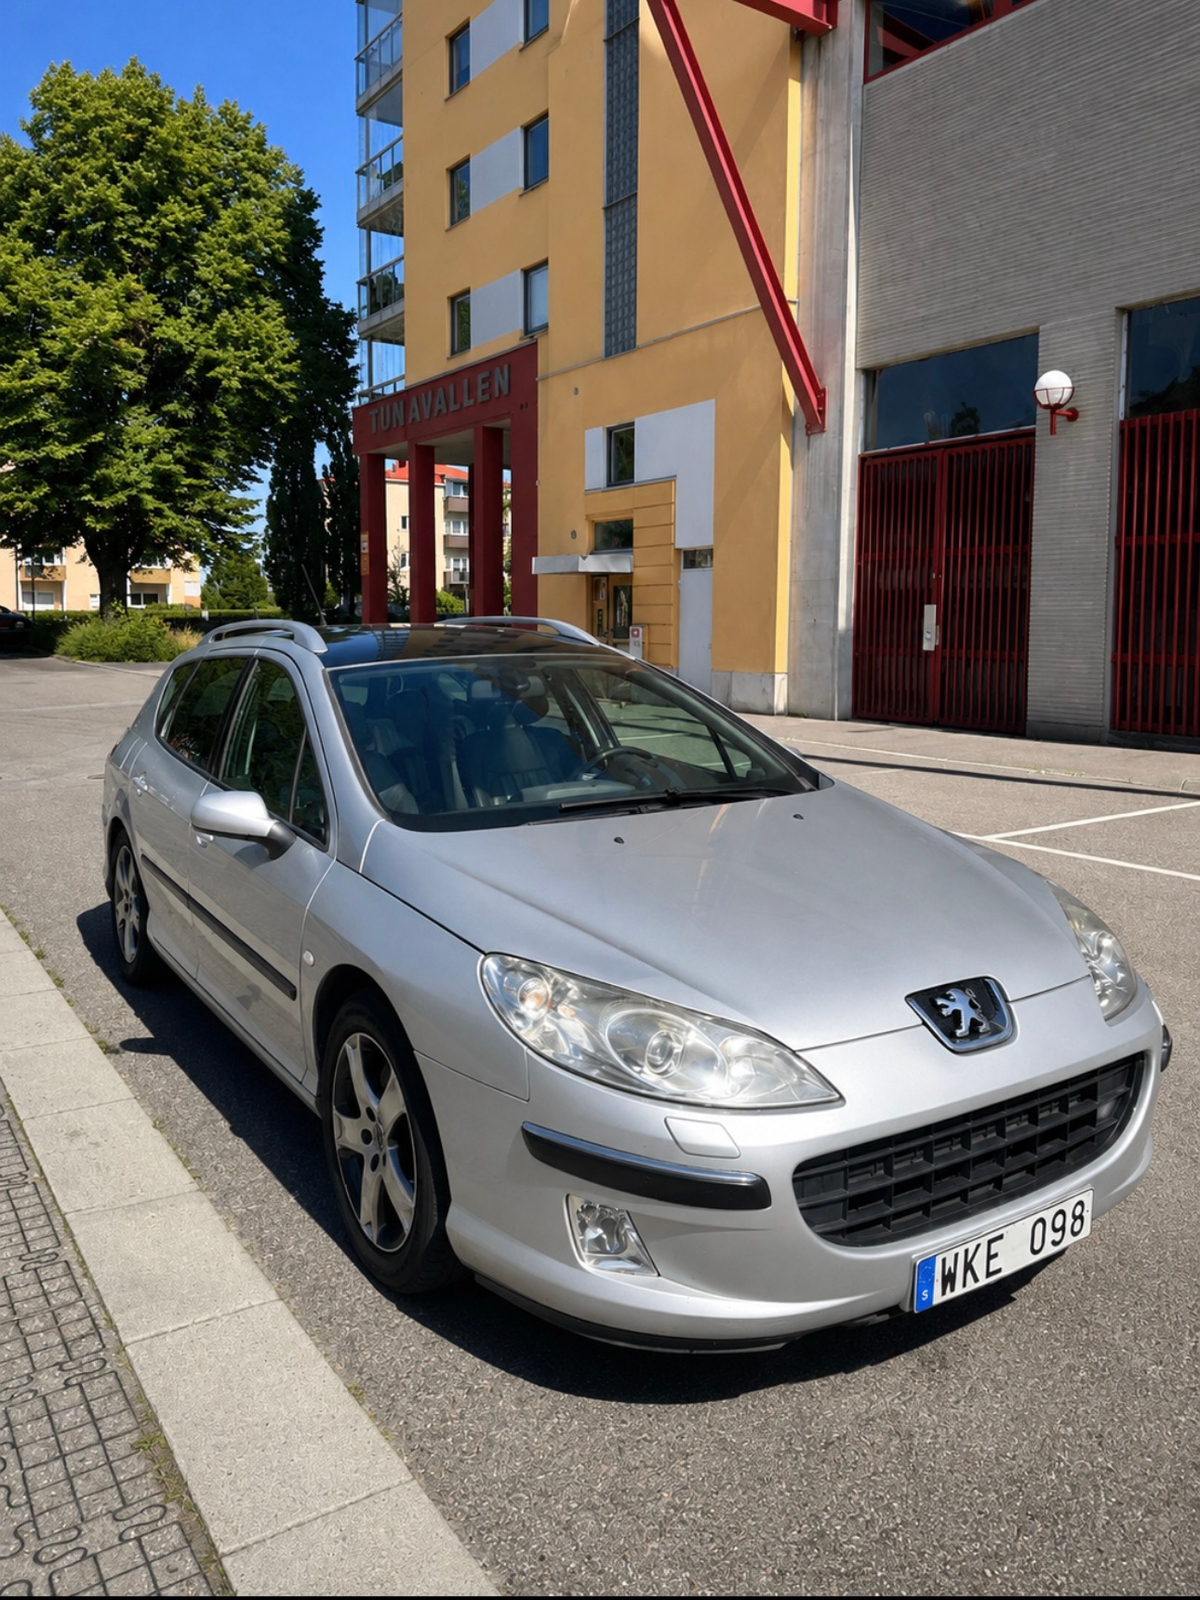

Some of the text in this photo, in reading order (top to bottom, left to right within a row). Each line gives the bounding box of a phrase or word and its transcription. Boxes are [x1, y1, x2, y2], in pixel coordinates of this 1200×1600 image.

[369, 363, 511, 434] TUNAVALLEN
[922, 1200, 1085, 1301] S WKE 098
